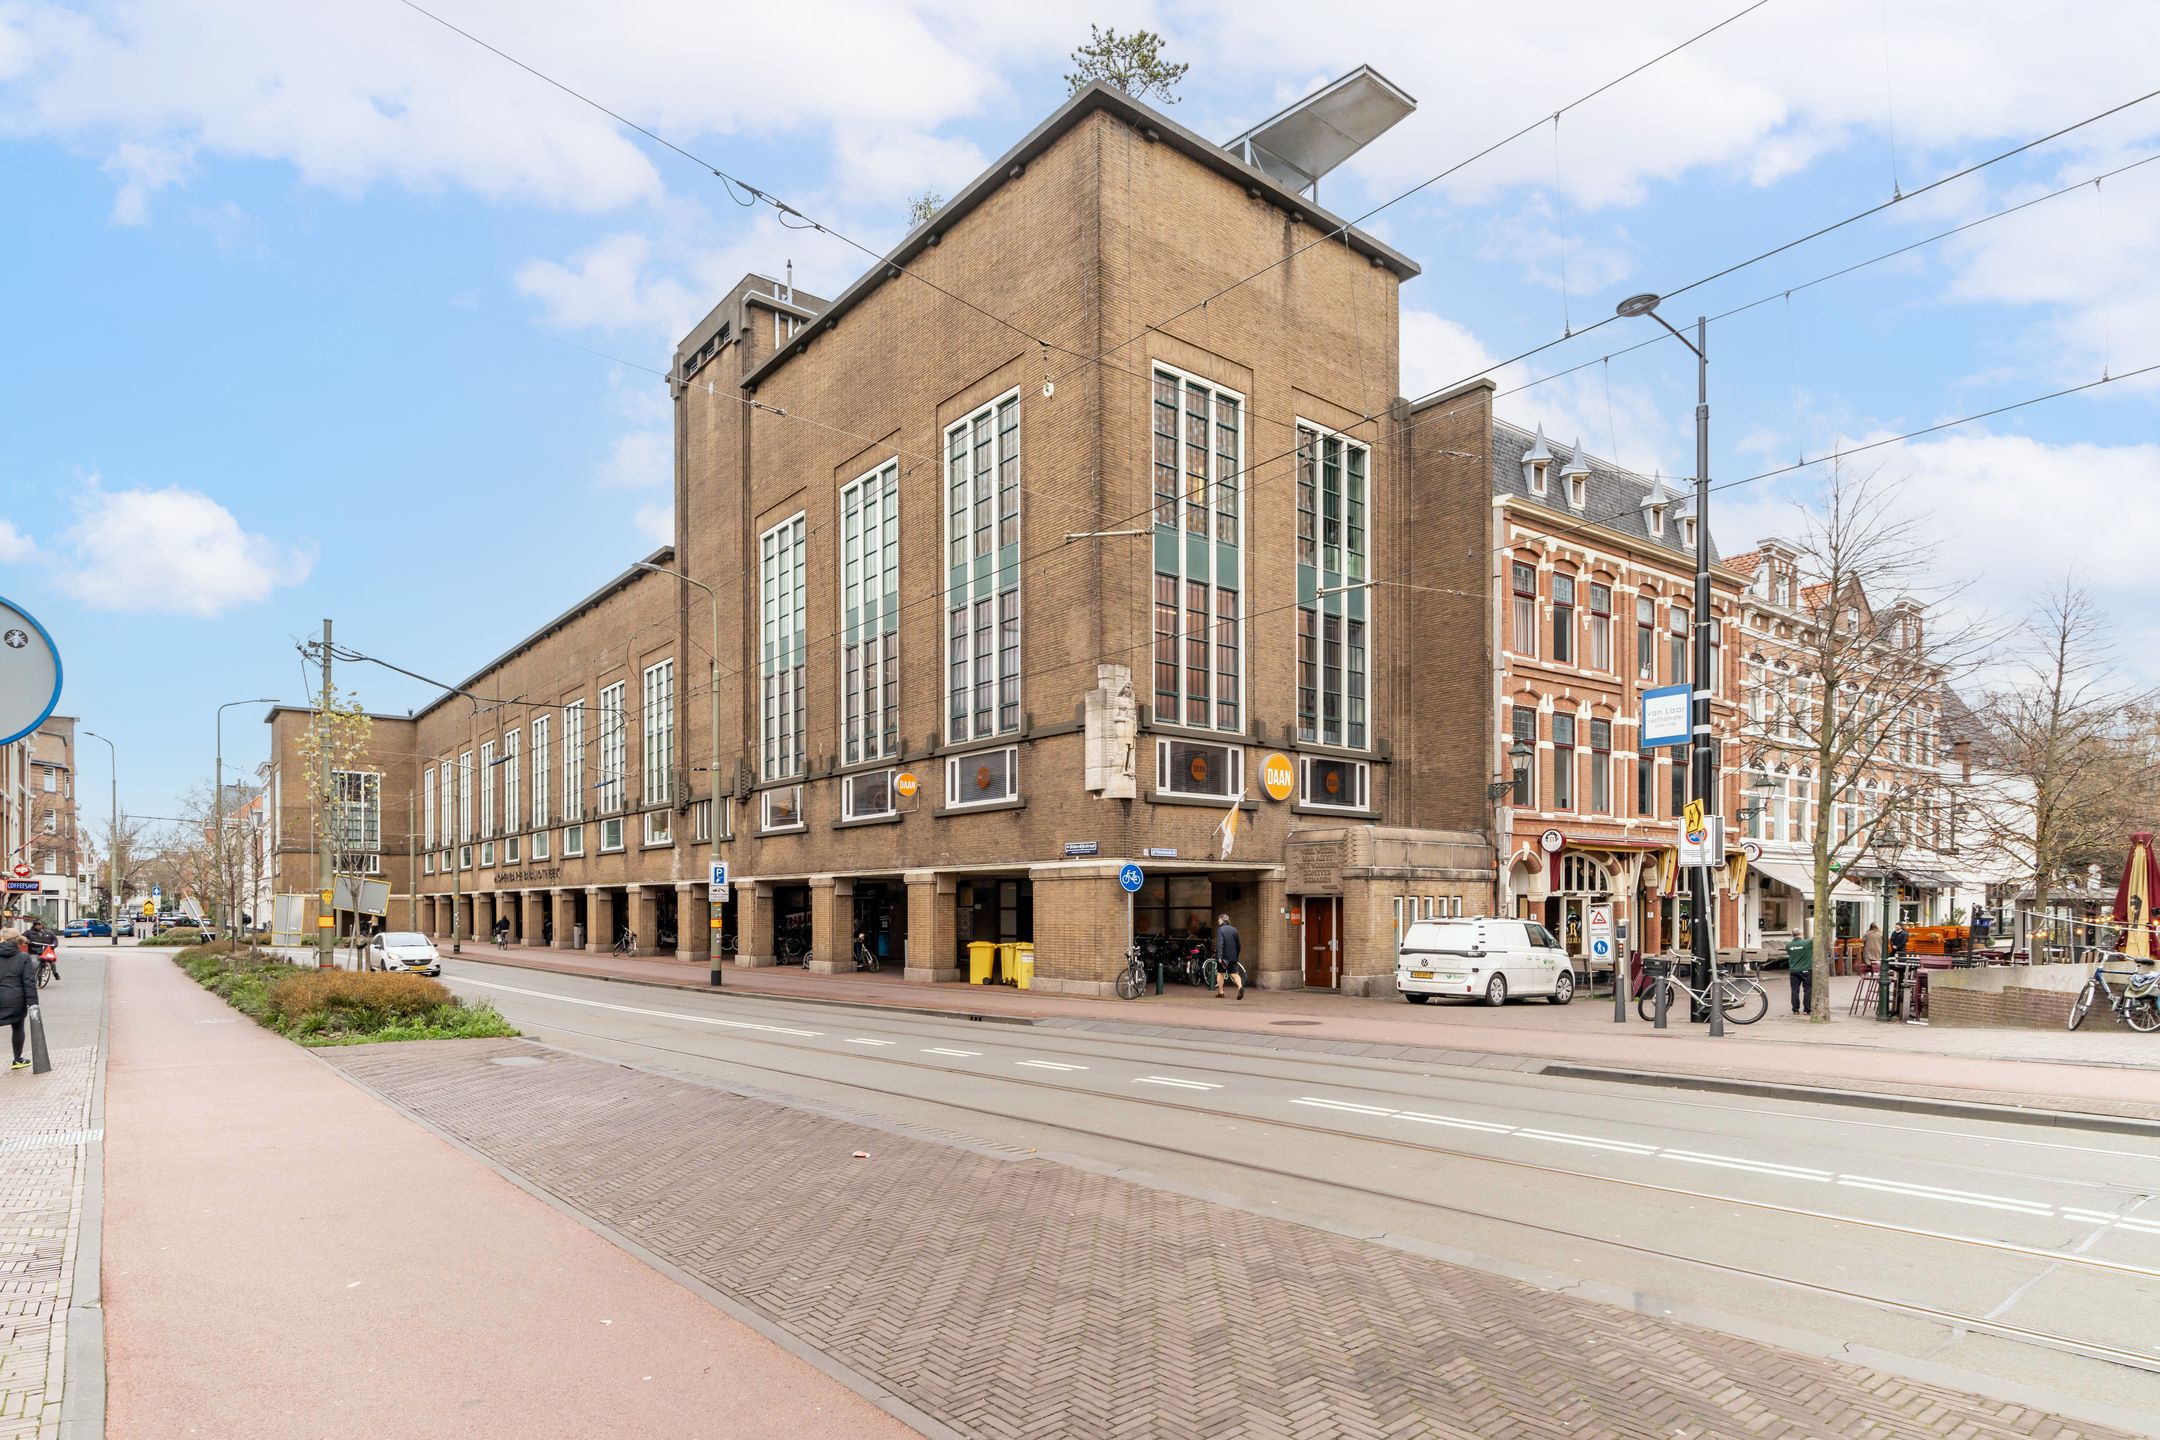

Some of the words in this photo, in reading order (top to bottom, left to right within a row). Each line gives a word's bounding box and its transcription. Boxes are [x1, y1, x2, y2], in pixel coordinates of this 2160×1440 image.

[1665, 706, 1685, 715] Laar
[1647, 714, 1684, 724] verfhandel
[1267, 767, 1291, 787] DAAN
[899, 780, 916, 790] DAAN
[716, 868, 723, 877] P
